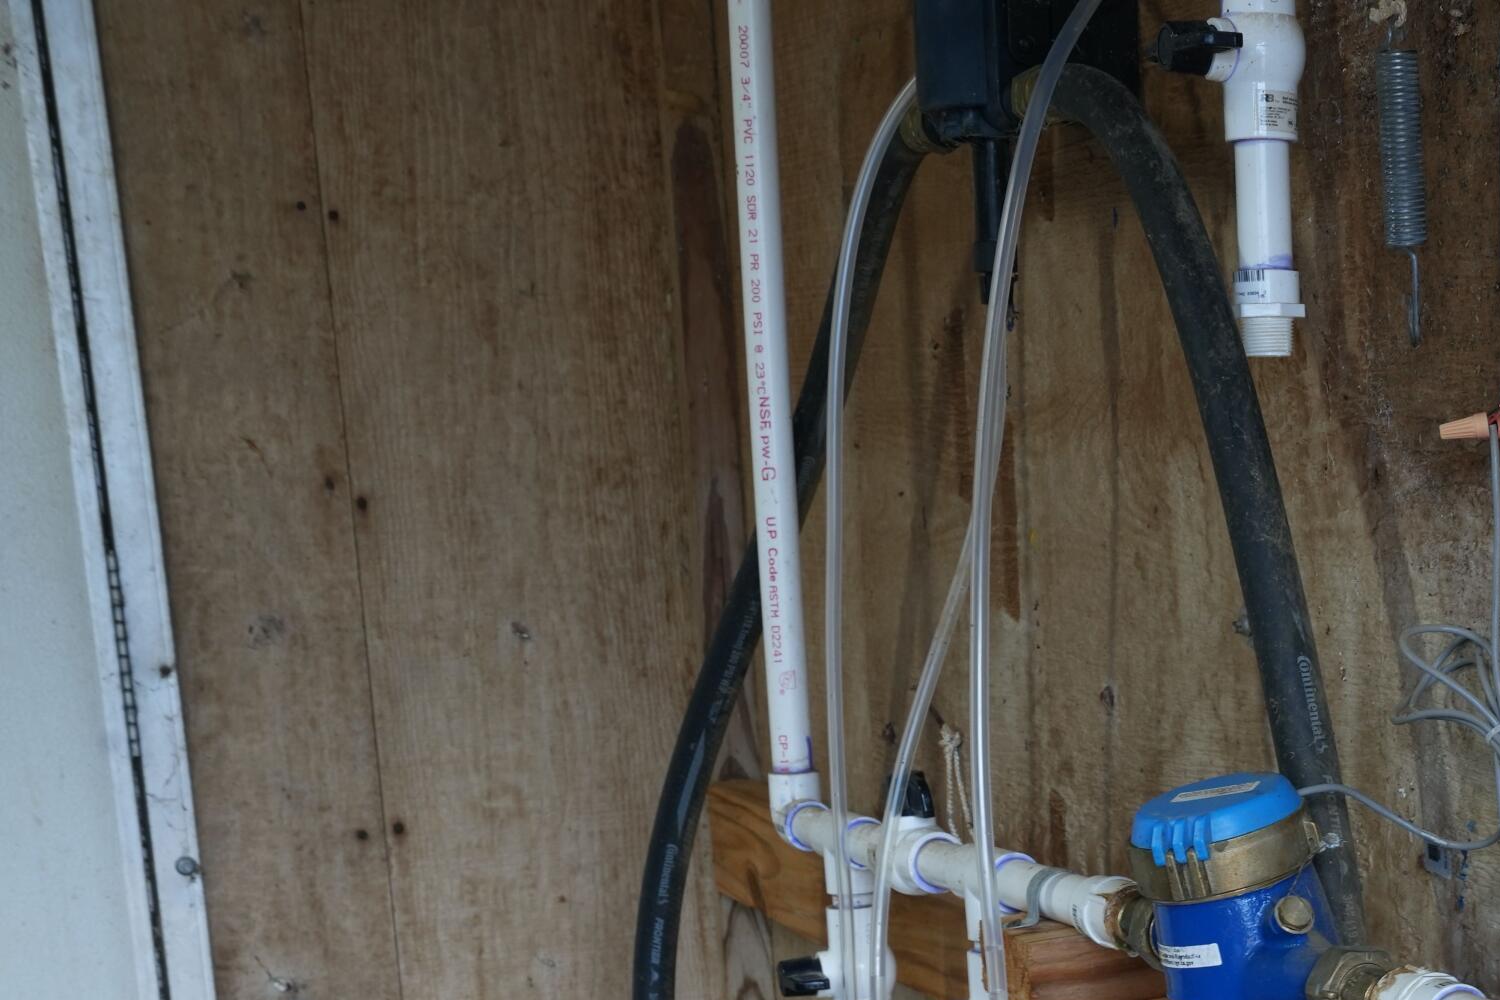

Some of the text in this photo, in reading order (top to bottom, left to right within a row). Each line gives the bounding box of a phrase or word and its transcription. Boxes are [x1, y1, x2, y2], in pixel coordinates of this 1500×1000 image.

[743, 118, 754, 144] PVC
[744, 154, 756, 186] 1120
[746, 195, 757, 221] SDR
[748, 229, 758, 244] 21
[750, 253, 760, 271] PR
[751, 279, 761, 303] 200
[753, 312, 764, 336] PSI
[768, 547, 779, 582] Code
[769, 585, 780, 618] ASTM
[771, 625, 782, 664] D2241
[1297, 655, 1325, 742] Continental
